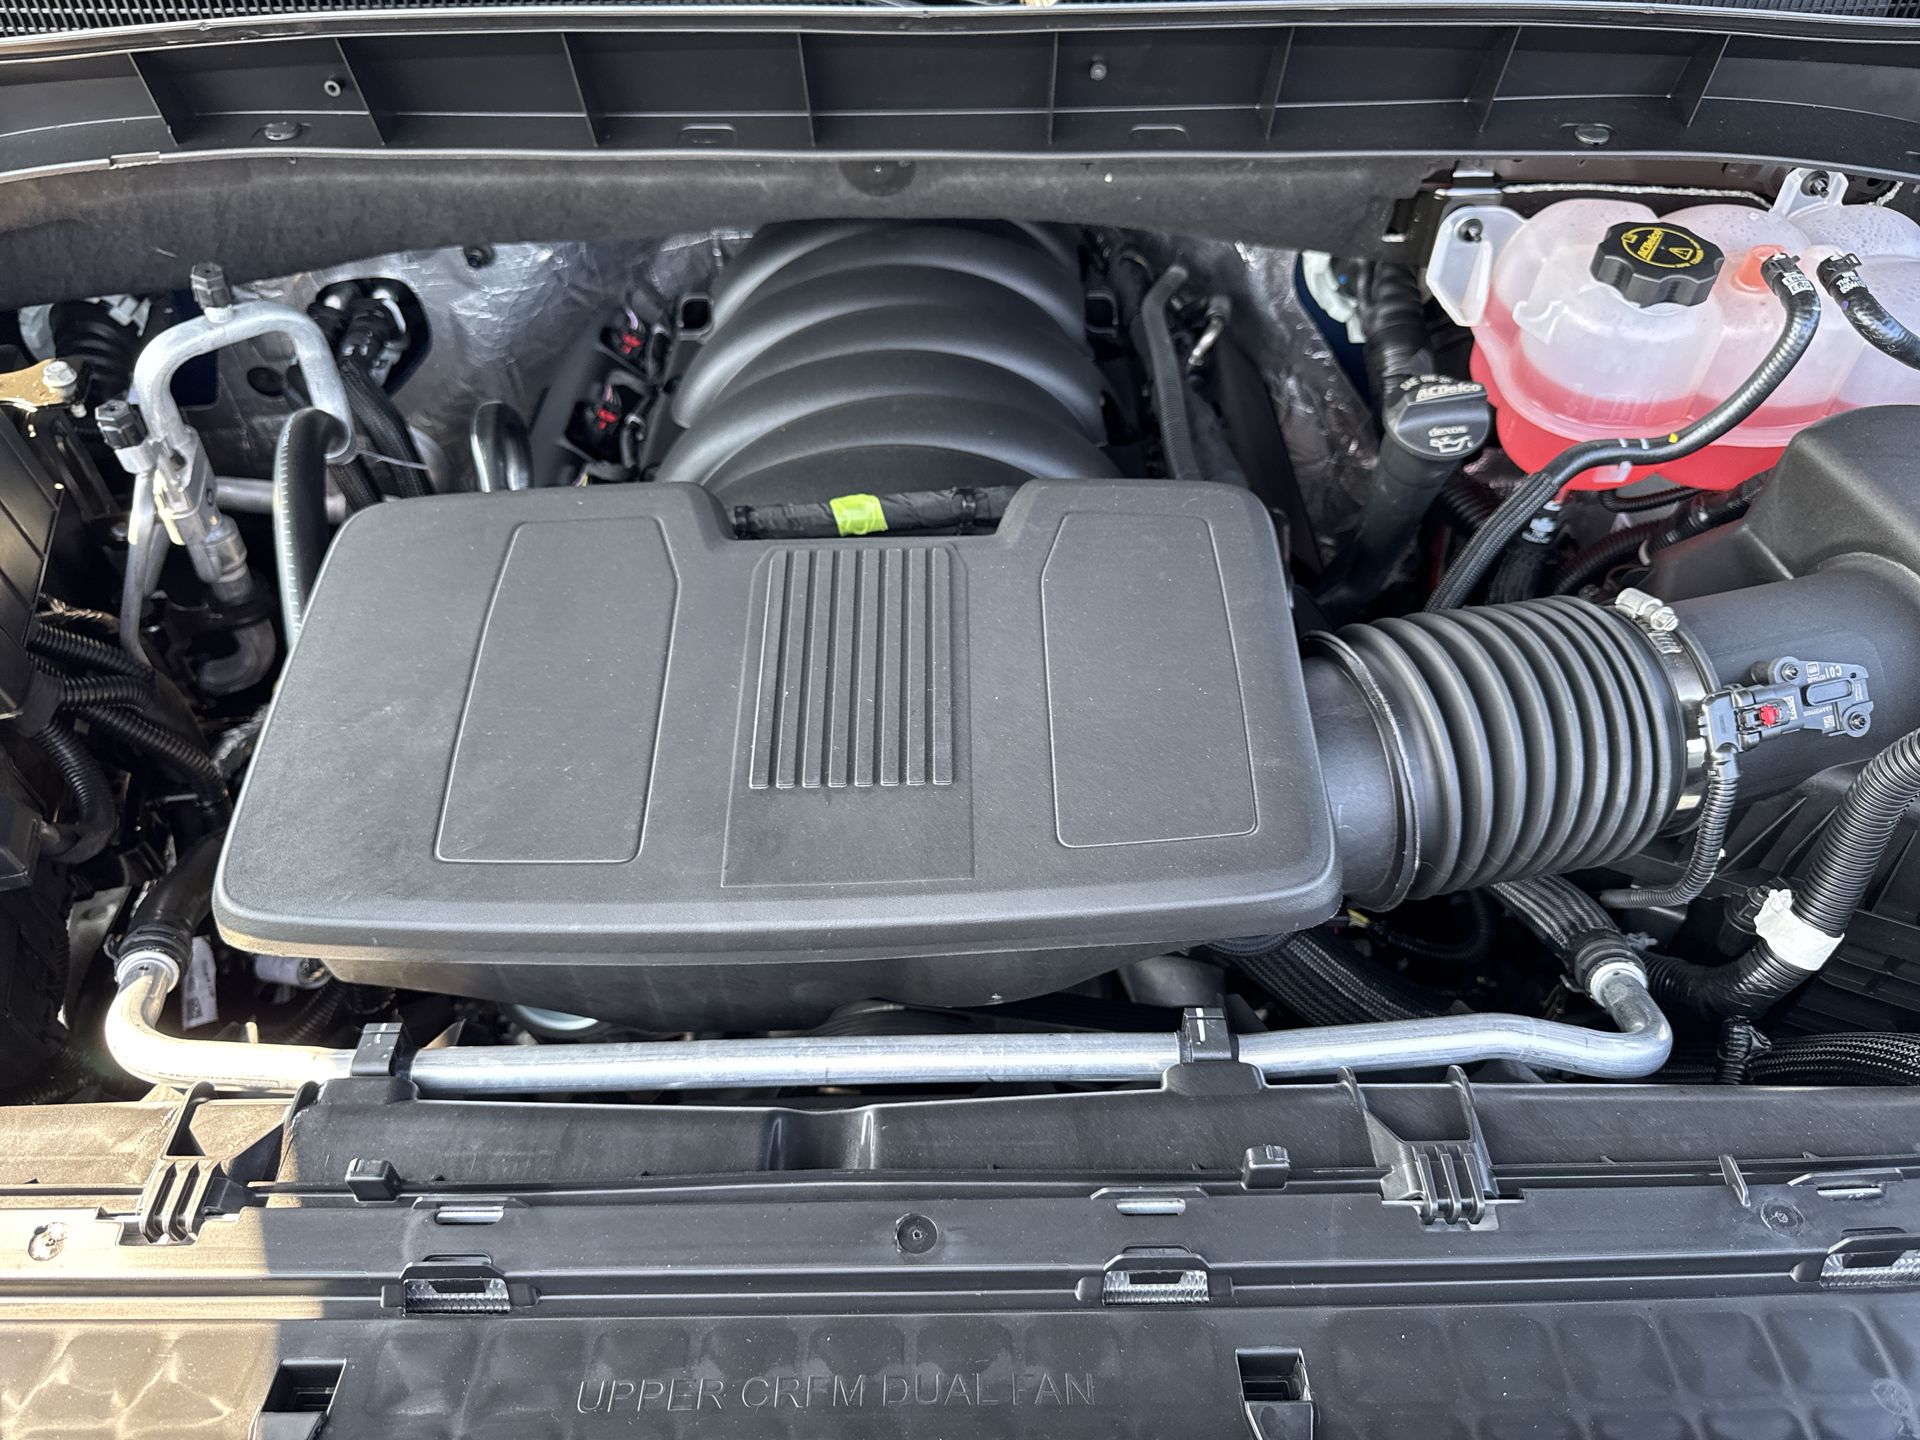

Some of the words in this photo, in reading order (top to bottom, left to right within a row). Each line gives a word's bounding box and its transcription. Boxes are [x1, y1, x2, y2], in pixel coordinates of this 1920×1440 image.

[1637, 228, 1663, 259] ACDelco
[1415, 381, 1483, 402] ACDelco
[1428, 425, 1468, 437] dexos
[576, 1377, 725, 1414] UPPER
[883, 1372, 999, 1407] DUAL
[1012, 1371, 1095, 1406] FAN
